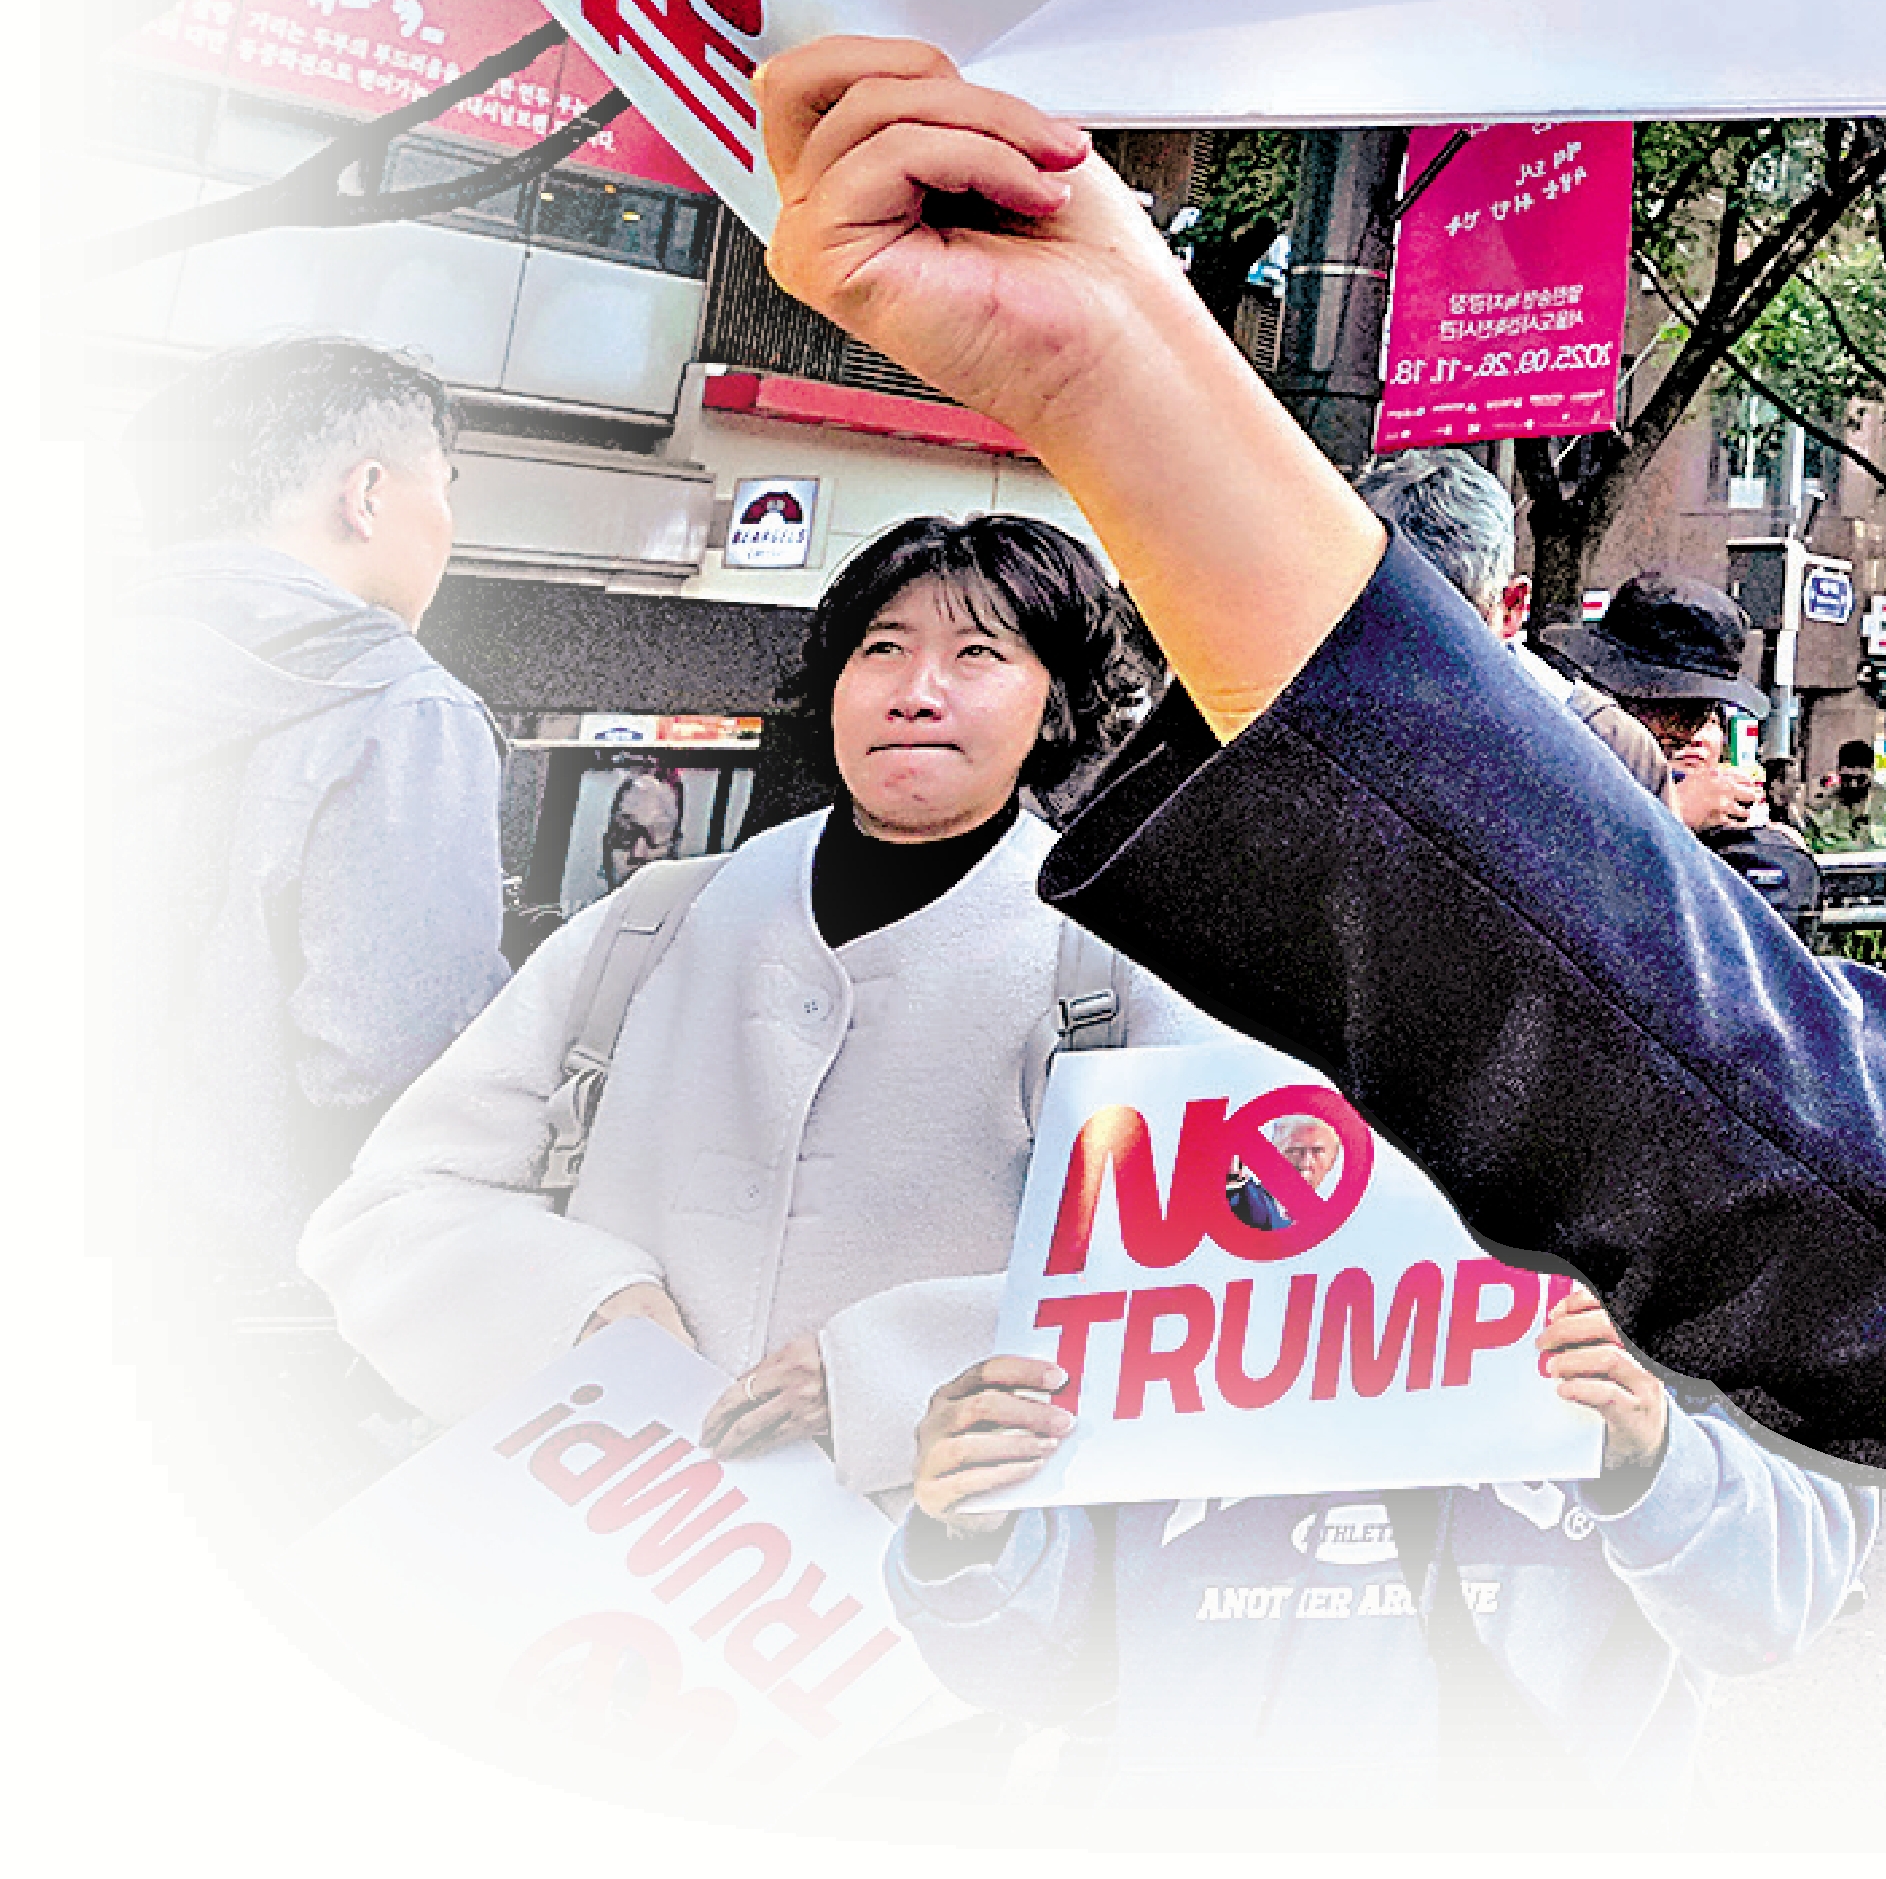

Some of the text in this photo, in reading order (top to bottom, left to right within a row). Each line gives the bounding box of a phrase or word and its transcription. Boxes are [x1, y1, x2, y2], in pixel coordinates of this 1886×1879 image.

[1044, 1084, 1375, 1276] NO
[1033, 1256, 1585, 1421] TRUMP!
[493, 1383, 902, 1740] TRUMP!
[1196, 1586, 1353, 1620] ANOTER
